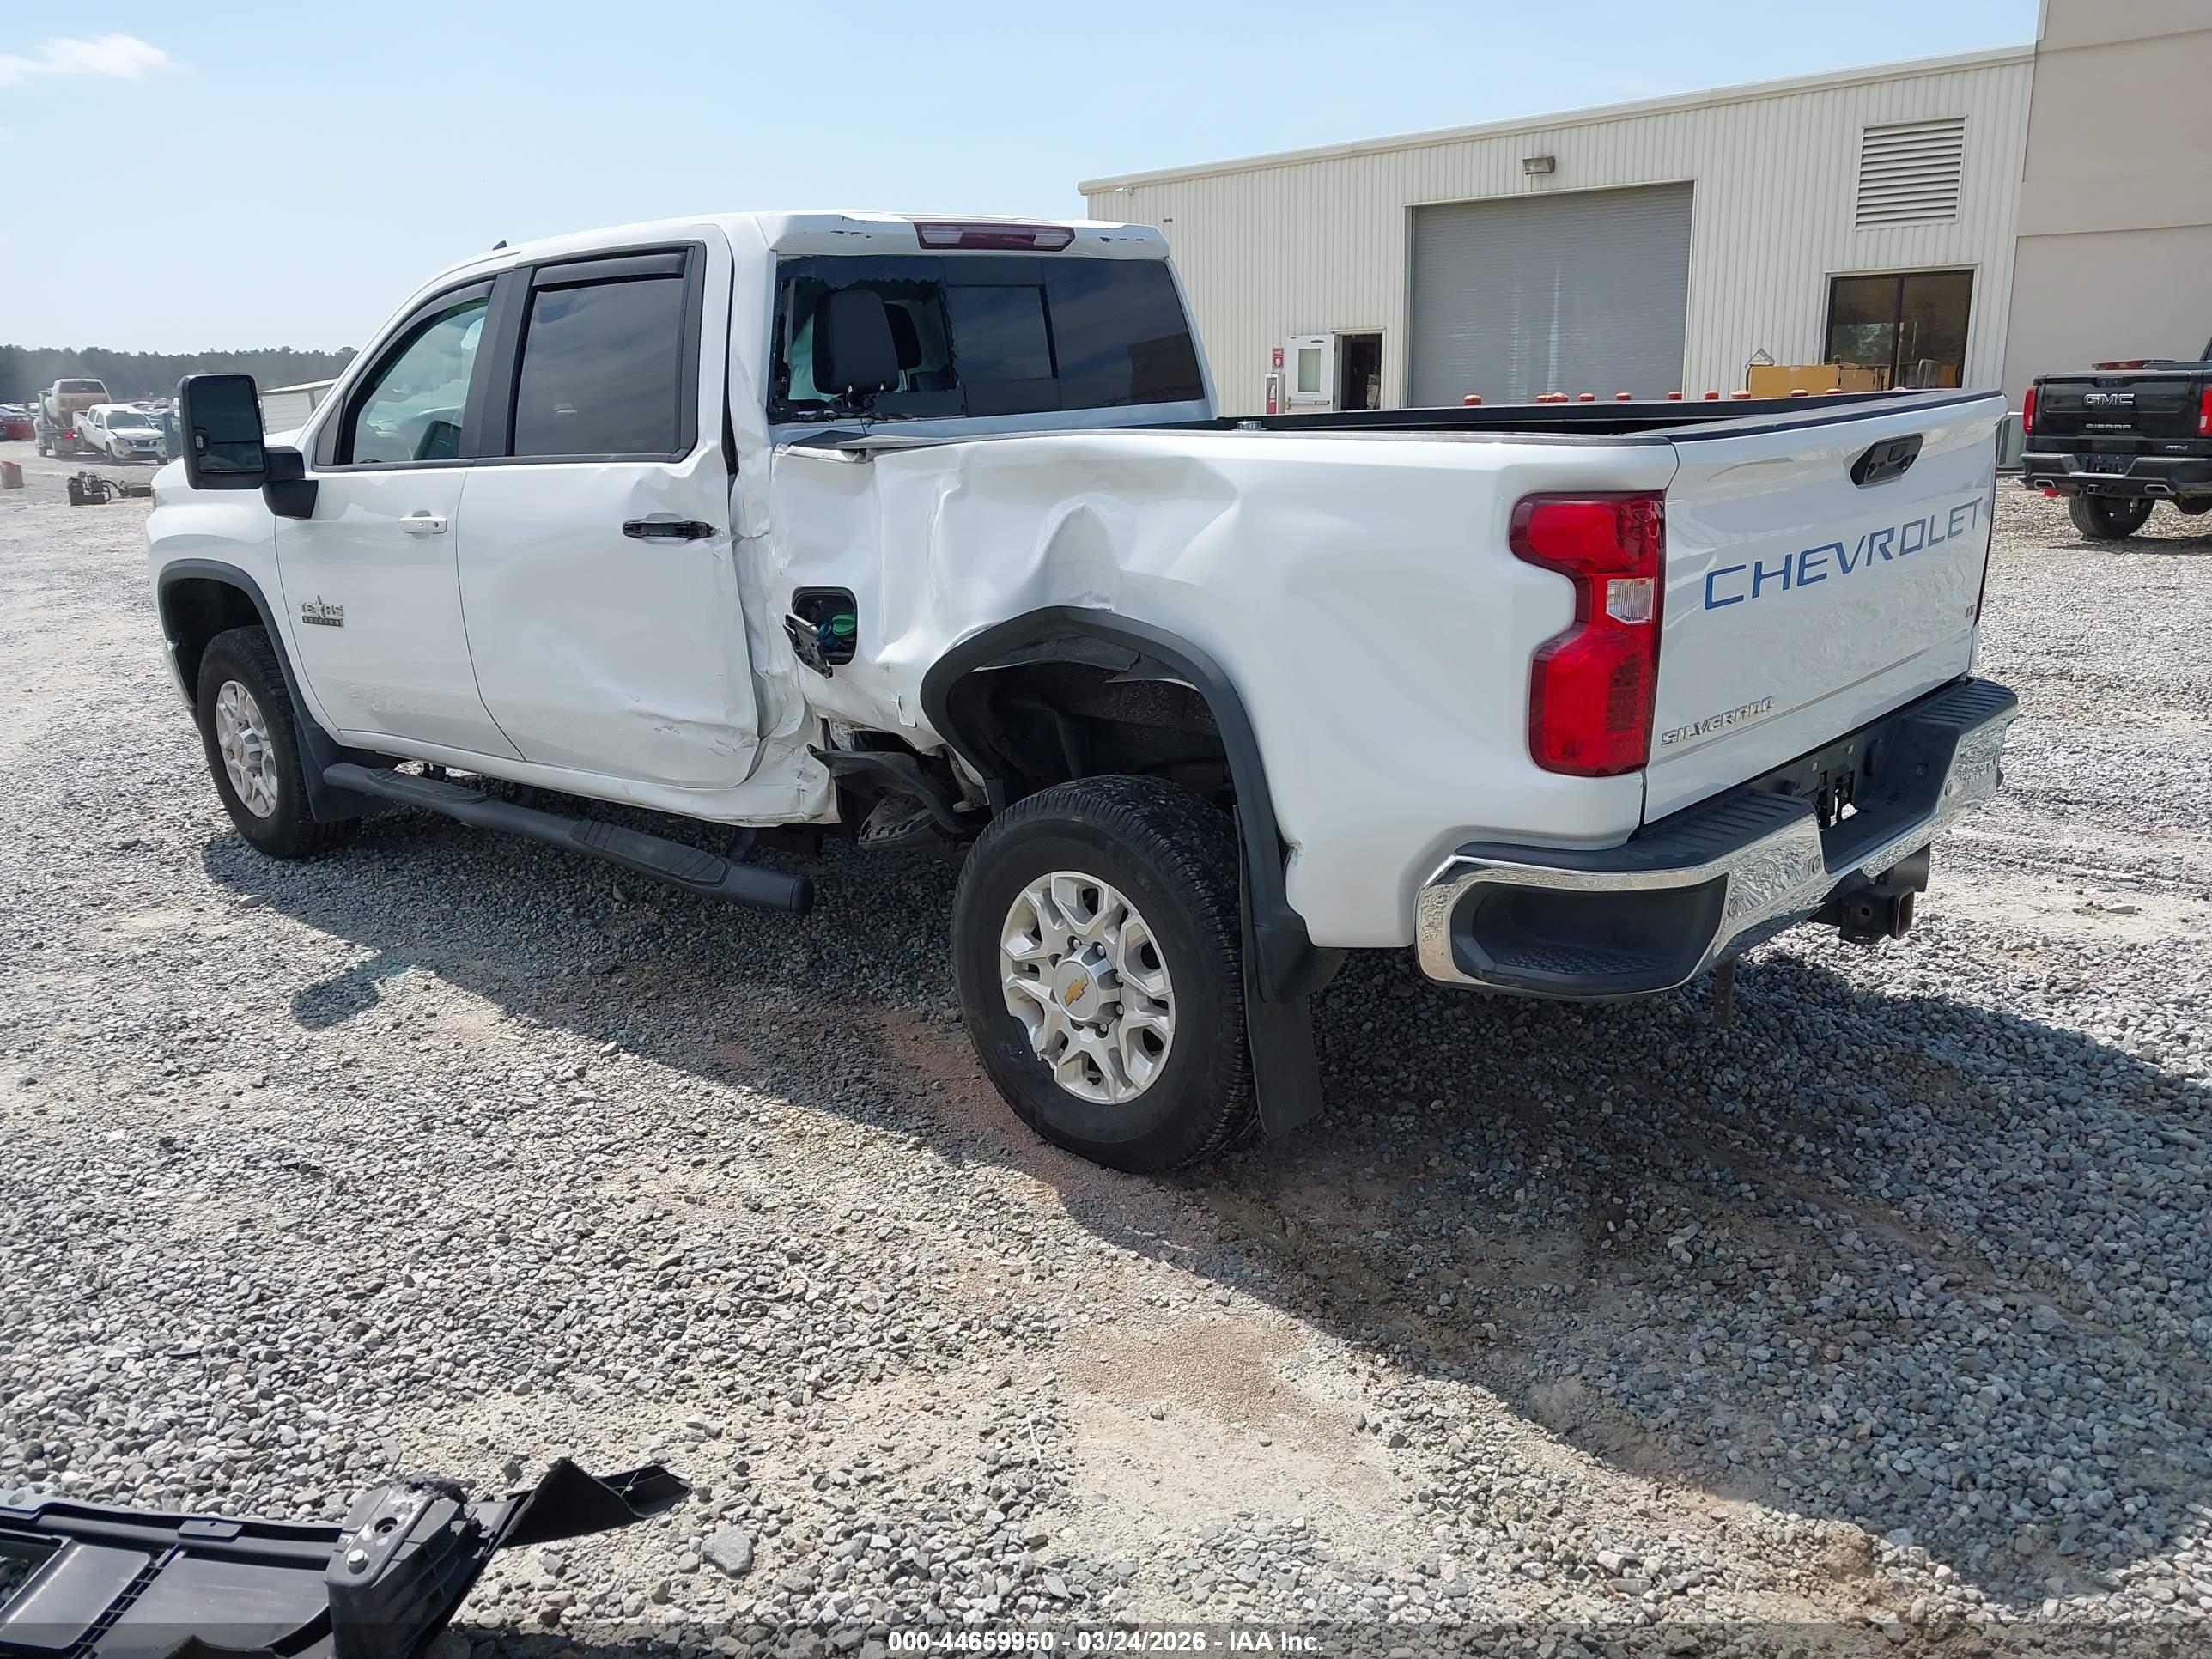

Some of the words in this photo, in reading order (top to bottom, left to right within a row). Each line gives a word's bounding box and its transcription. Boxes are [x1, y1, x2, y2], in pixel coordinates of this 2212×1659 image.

[2084, 393, 2135, 406] GMC
[1705, 496, 1983, 611] CHEVROLET
[1660, 696, 1774, 747] SILVERADO
